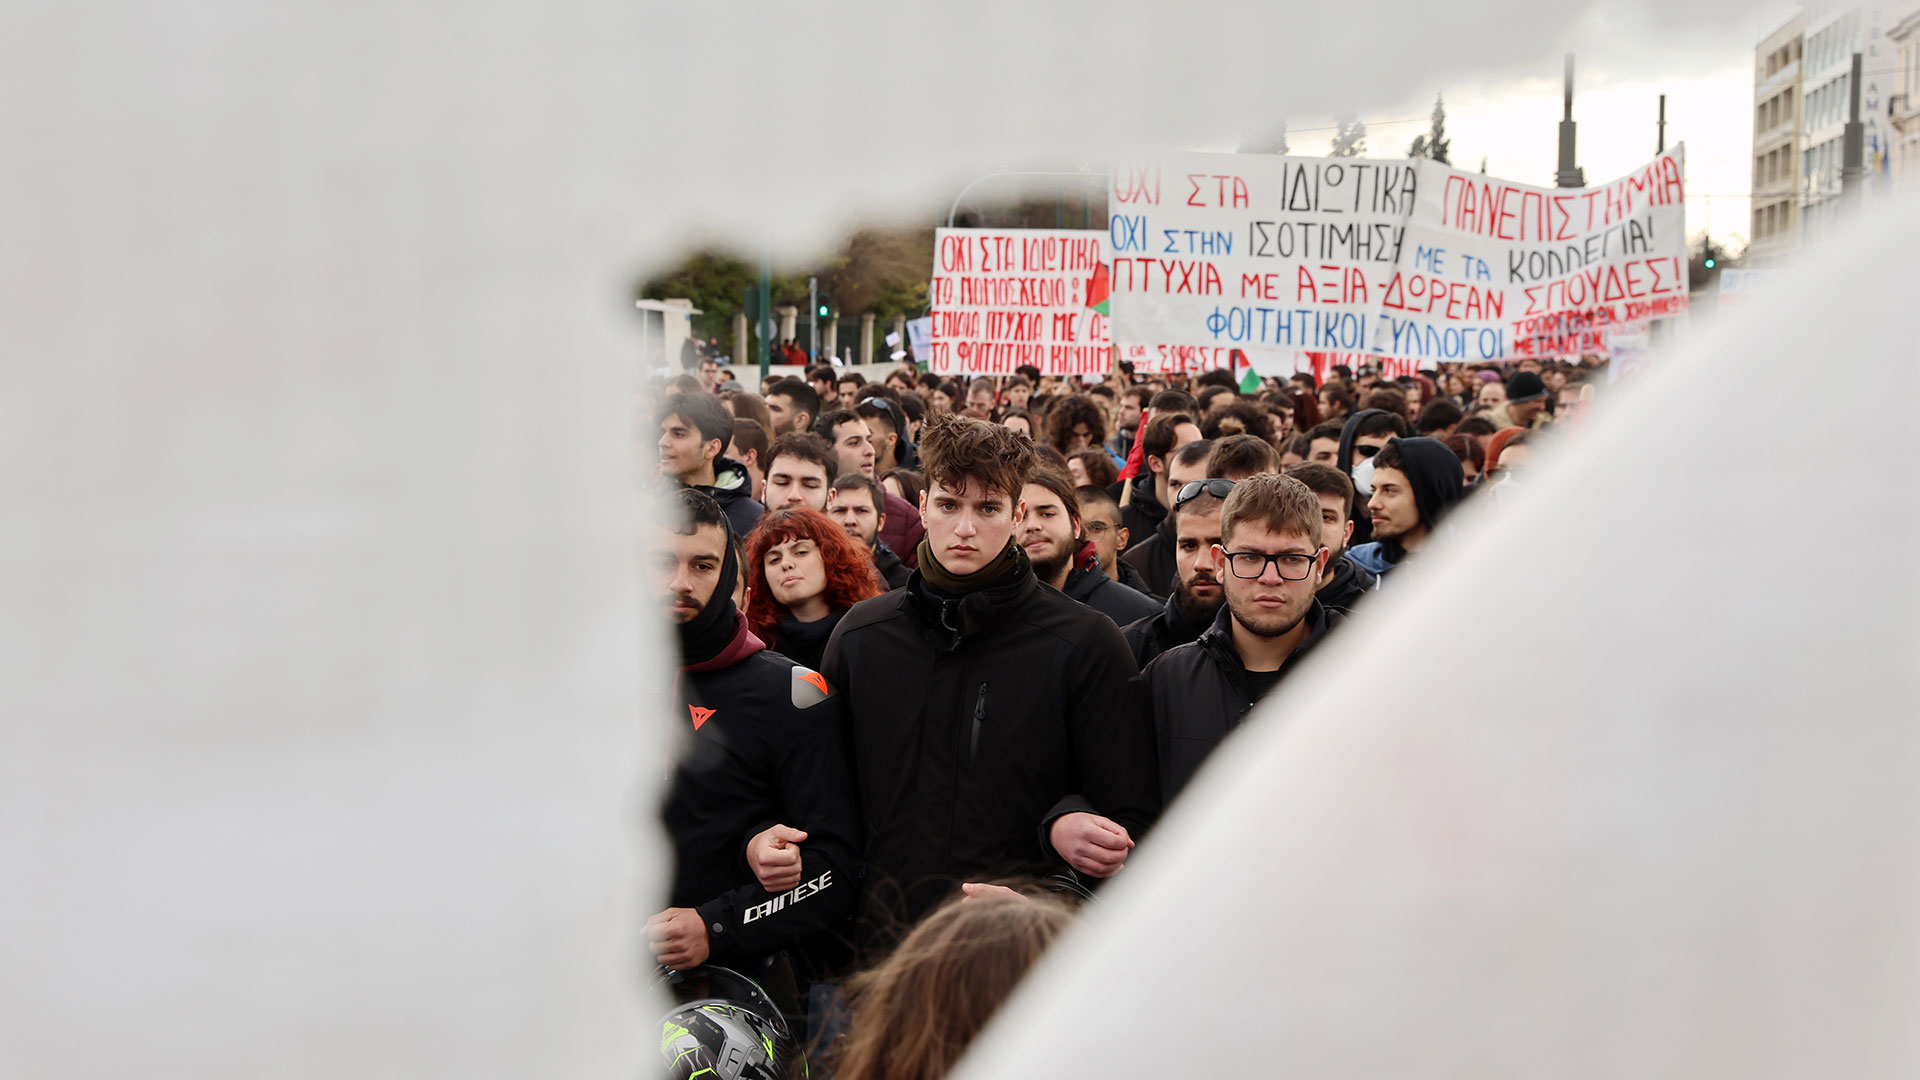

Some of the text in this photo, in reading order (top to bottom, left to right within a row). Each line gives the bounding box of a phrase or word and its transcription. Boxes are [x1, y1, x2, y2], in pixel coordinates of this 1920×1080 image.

[1187, 174, 1249, 208] ΣΤΑ
[1281, 162, 1417, 216] ΙΔΙΩΤΙΚΑ
[1442, 155, 1683, 242] ΠΑΝΕΠΙΣΤΗΜΙΑ
[941, 235, 1100, 272] ΟΧΙ ΣΤΑ ΙΔΙΩΤΙΚΑ
[1110, 214, 1146, 251] ΟΧΙ
[1164, 230, 1233, 256] ΣΤΗΝ
[1415, 245, 1446, 274] ΜΕ
[1462, 254, 1492, 281] ΤΑ
[1508, 215, 1655, 284] ΚΟΛΛΕΓΙΑ!
[933, 277, 954, 305] ΤΟ
[960, 277, 1066, 308] ΝΟΜΟΣΧΕΔΙΟ
[1112, 257, 1222, 296] ΠΤΥΧΙΑ
[1241, 273, 1279, 299] ΜΕ
[1298, 264, 1368, 304] ΑΞΙΑ
[1524, 256, 1682, 316] ΣΠΟΥΔΕΣ!
[930, 311, 980, 339] ΕΝΙΑΙΑ
[986, 311, 1043, 341] ΠΤΥΧΙΑ
[1052, 313, 1078, 342] ΜΕ
[1206, 306, 1366, 349] ΦΟΙΤΗΤΙΚΟΙ
[930, 342, 950, 371] ΤΟ
[957, 341, 1044, 373] ΦΟΙΤΗΤΙΚΟ
[743, 870, 832, 924] DAINESE
